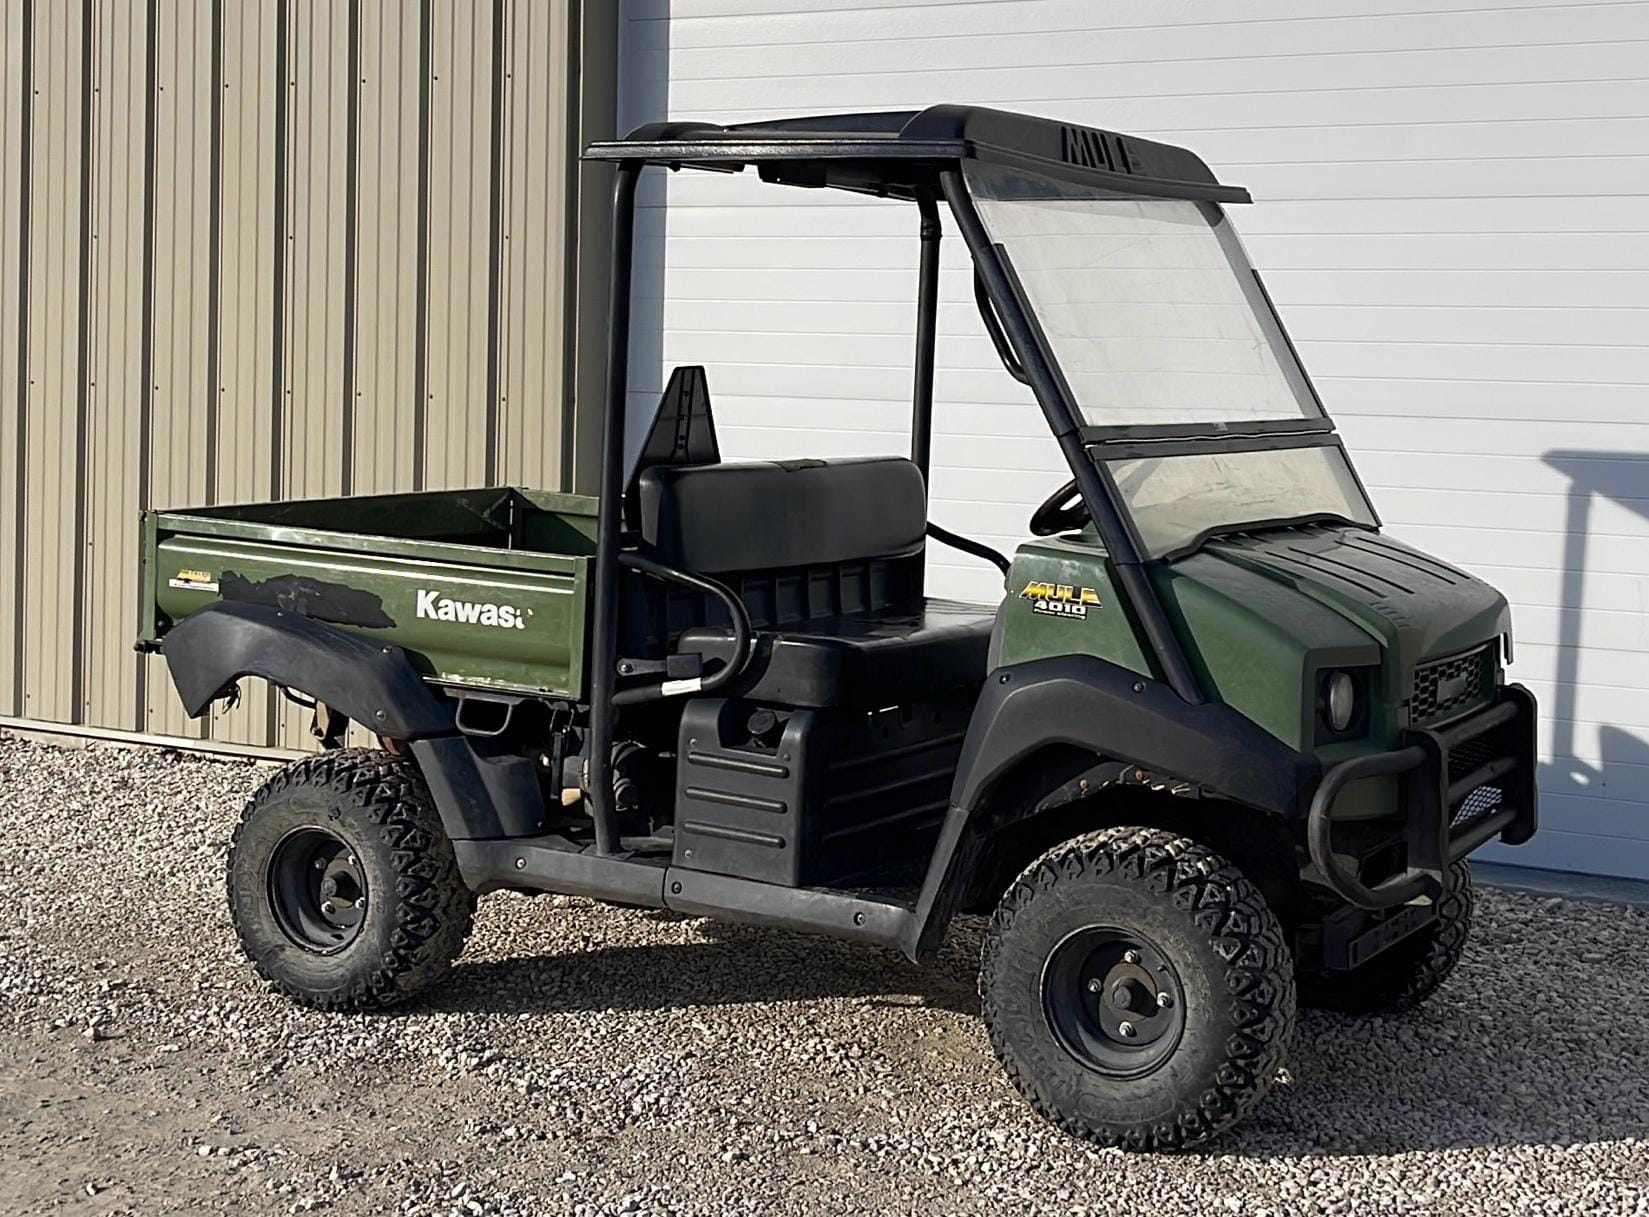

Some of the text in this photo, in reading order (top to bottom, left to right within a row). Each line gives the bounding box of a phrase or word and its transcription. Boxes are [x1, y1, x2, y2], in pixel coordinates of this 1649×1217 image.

[416, 588, 534, 630] Kawas
[1018, 580, 1104, 609] MULE
[1034, 600, 1087, 615] 4010
